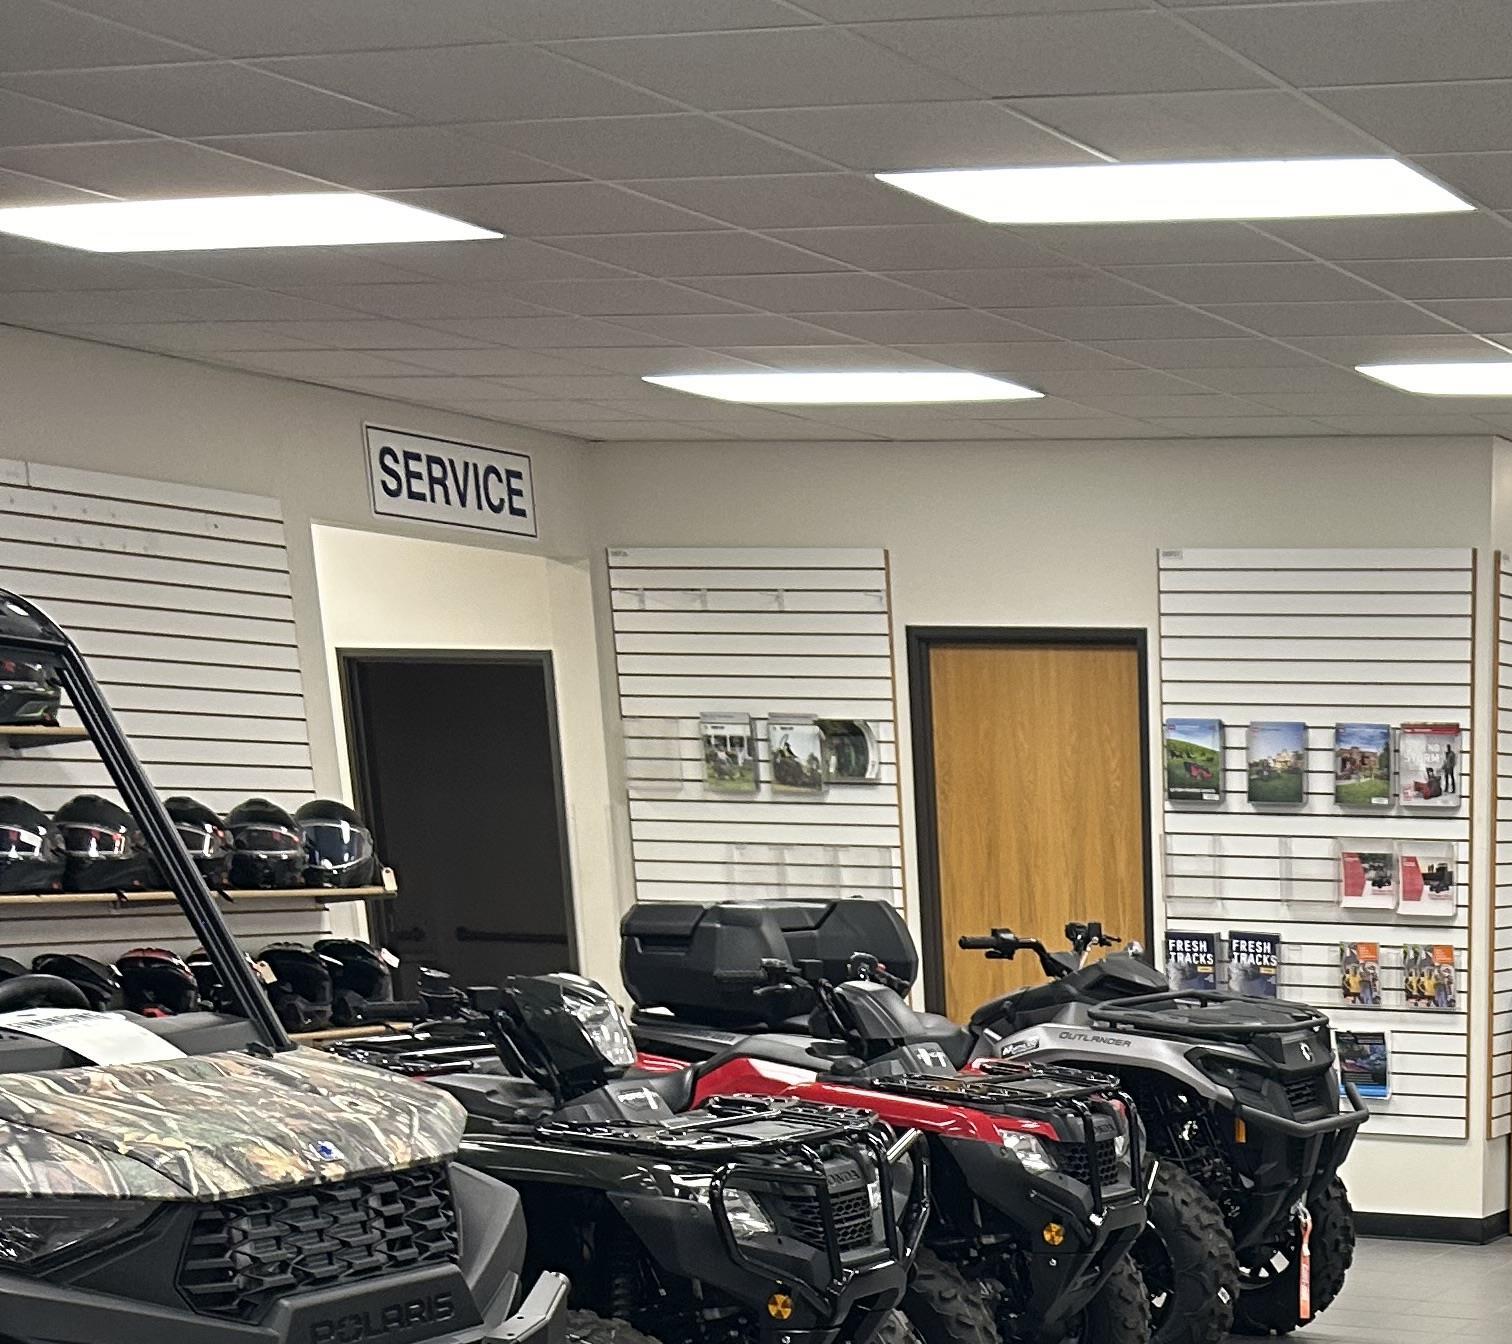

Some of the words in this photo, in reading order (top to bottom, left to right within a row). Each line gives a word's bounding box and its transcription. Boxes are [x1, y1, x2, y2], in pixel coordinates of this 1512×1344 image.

[378, 445, 528, 519] SERVICE
[1168, 940, 1208, 953] FRESH
[1232, 940, 1271, 953] FRESH
[1169, 952, 1214, 965] TRACKS
[1233, 952, 1278, 967] TRACKS
[1059, 1032, 1132, 1047] OUTLANDER
